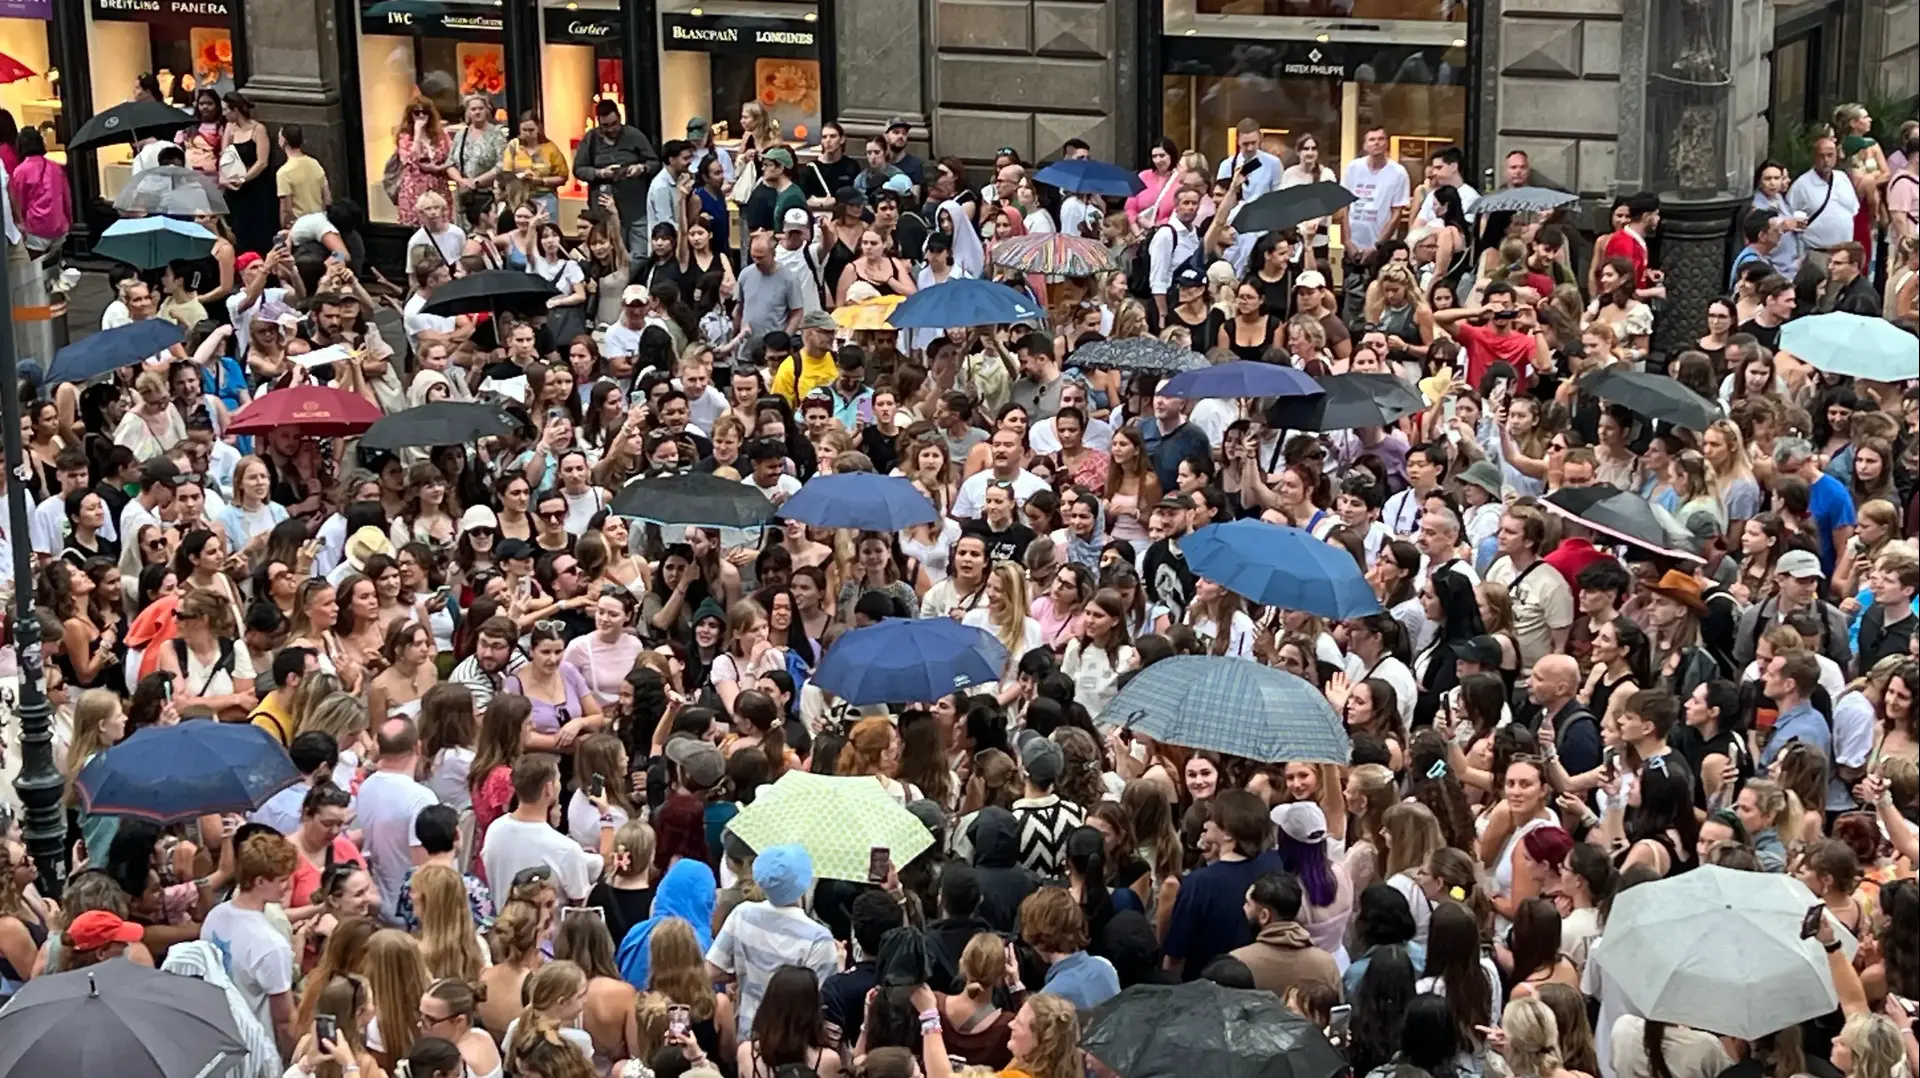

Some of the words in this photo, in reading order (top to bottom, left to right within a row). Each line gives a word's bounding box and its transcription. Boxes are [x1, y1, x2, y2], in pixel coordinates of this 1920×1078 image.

[100, 0, 160, 11] BREITLING
[388, 11, 413, 25] IWC
[568, 20, 610, 36] Cartier
[672, 26, 738, 42] BLANCPAIN
[755, 31, 814, 45] LONGINES
[1285, 64, 1309, 74] PATEK
[1310, 65, 1344, 77] PHILIPPE
